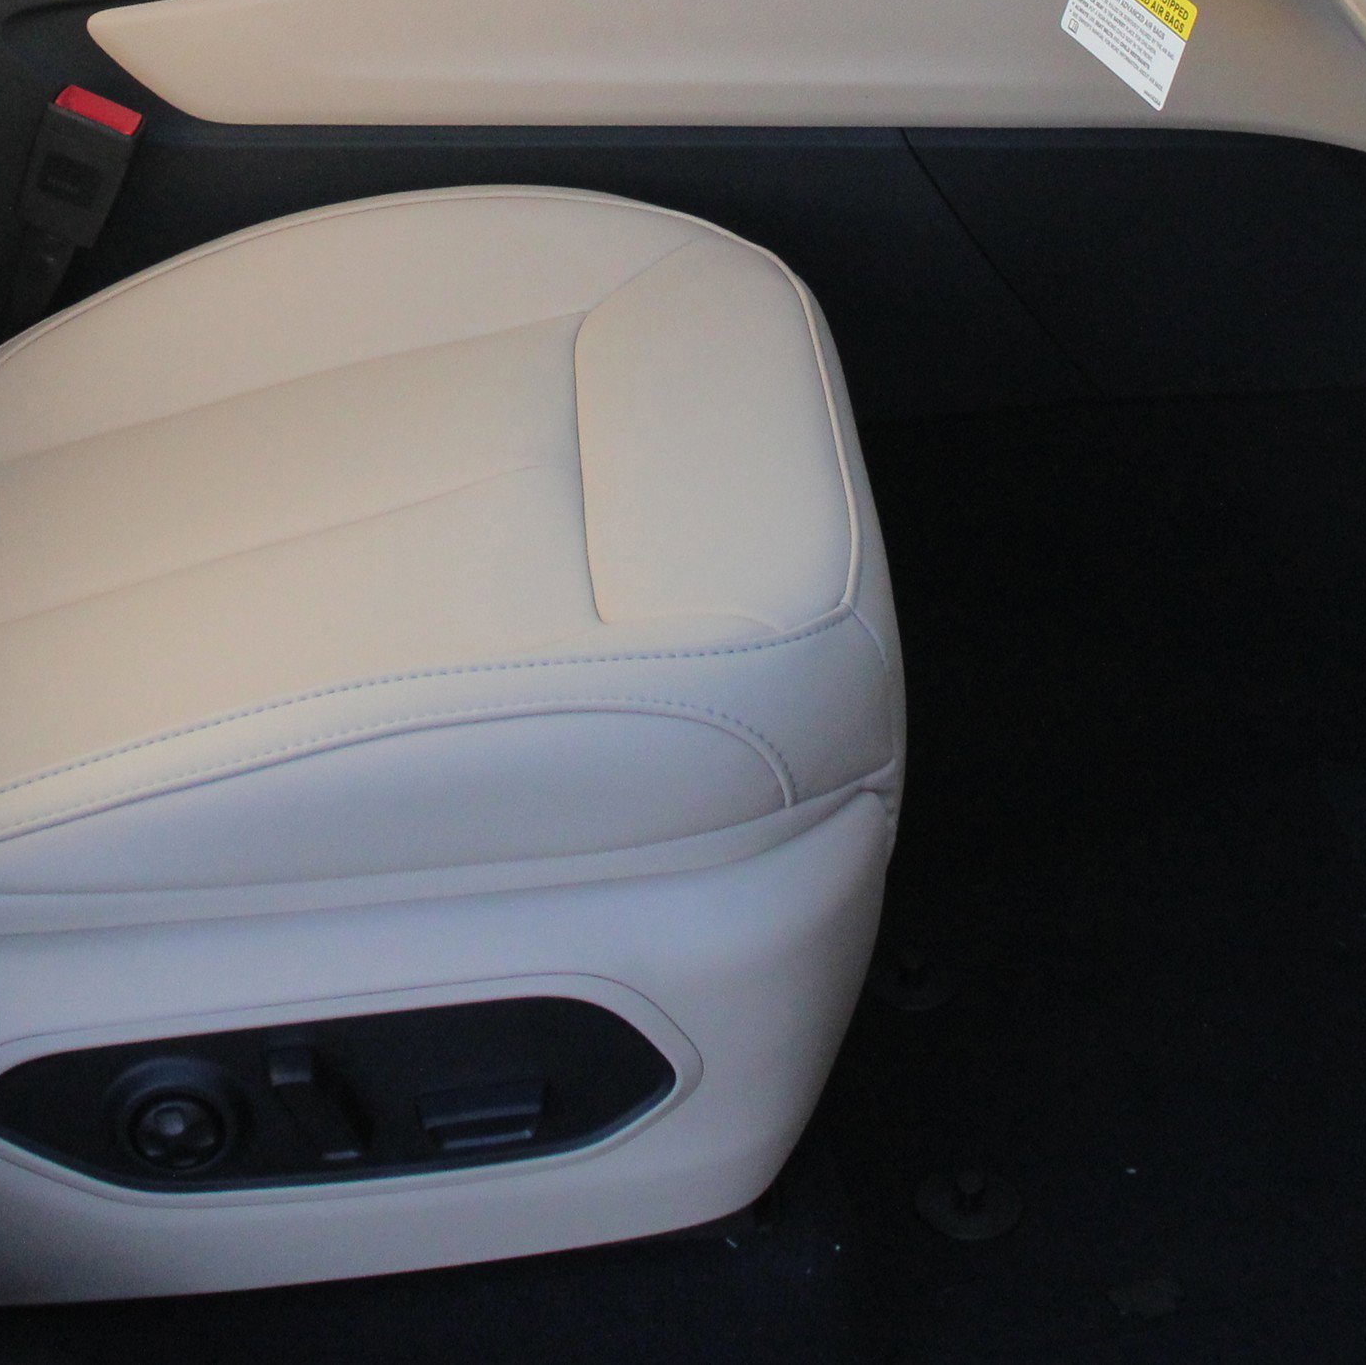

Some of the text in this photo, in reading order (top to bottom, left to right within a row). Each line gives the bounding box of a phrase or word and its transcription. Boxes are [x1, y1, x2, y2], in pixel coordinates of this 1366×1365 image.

[1121, 0, 1144, 22] ADVANCED
[1151, 0, 1163, 15] AIR
[1164, 10, 1184, 32] BAGS
